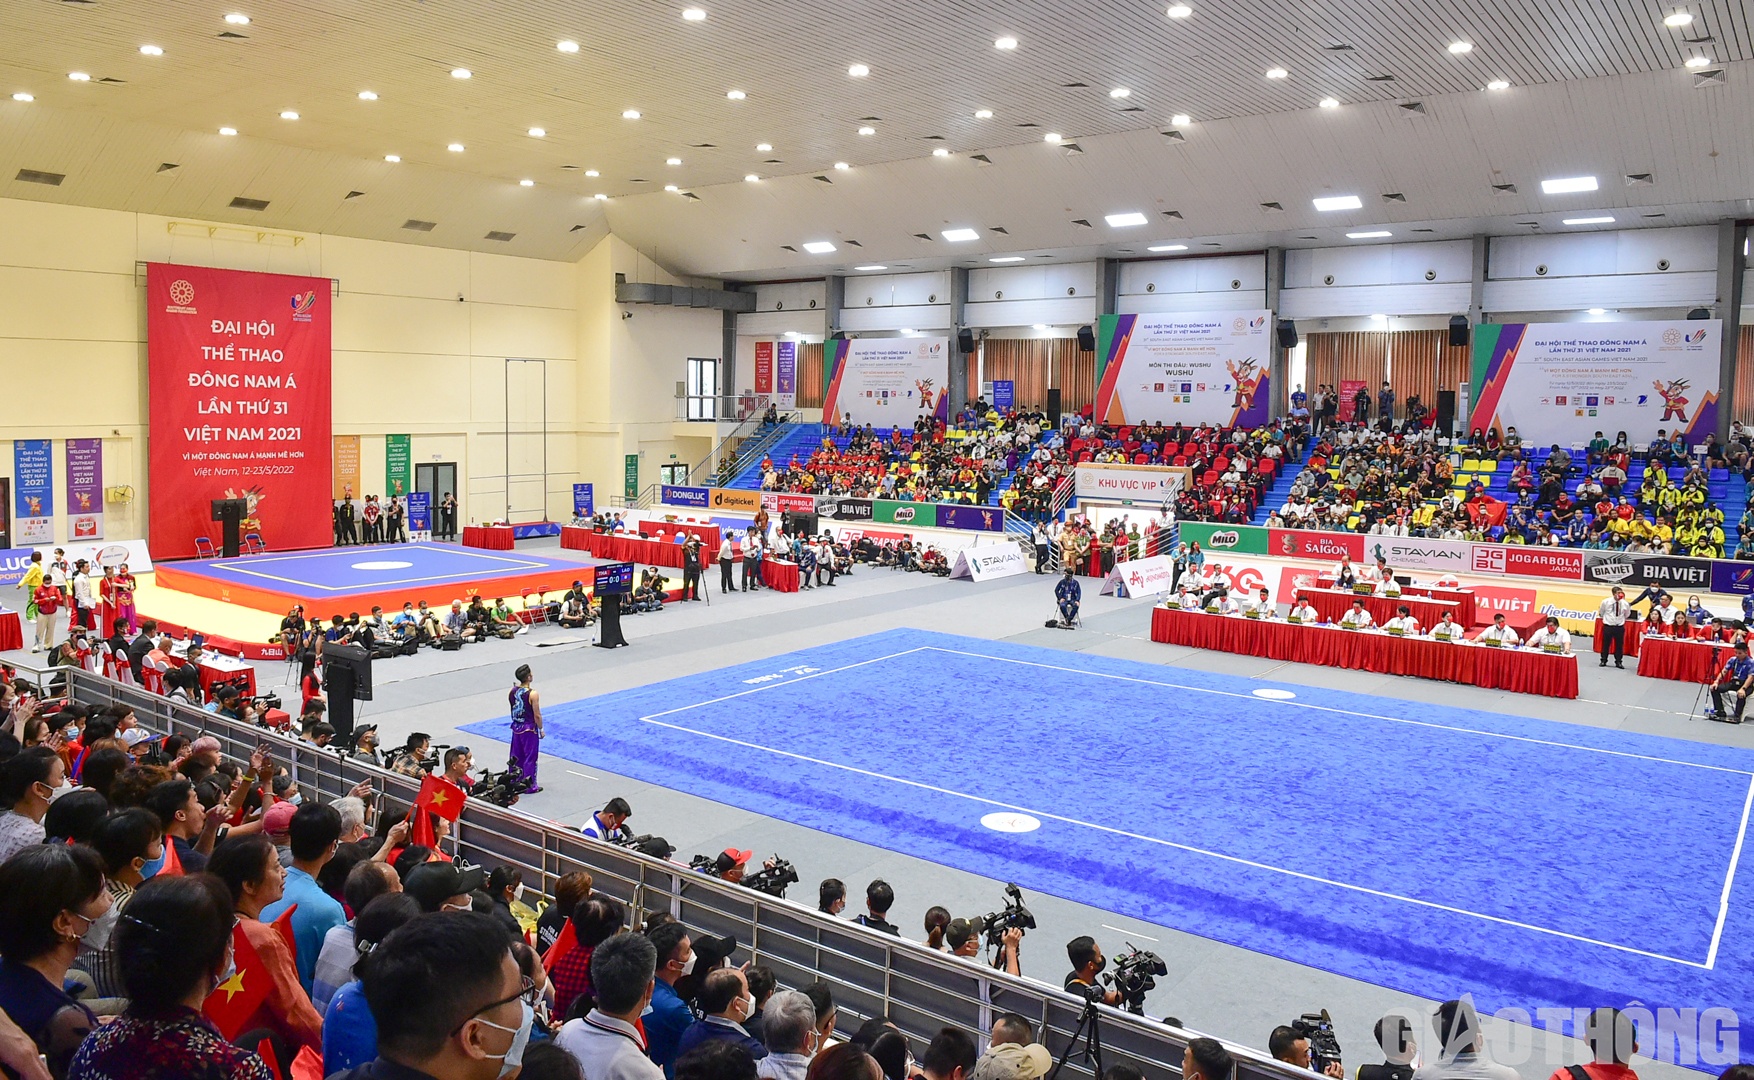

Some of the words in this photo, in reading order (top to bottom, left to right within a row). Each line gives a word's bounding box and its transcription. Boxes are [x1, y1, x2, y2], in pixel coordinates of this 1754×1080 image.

[211, 320, 240, 337] ĐẠI
[246, 320, 274, 339] HỘI
[201, 343, 234, 361] THỂ
[238, 348, 284, 362] THAO
[188, 370, 240, 388] ĐÔNG
[244, 376, 280, 388] NAM
[285, 372, 297, 389] Á
[198, 396, 232, 414] LẦN
[236, 398, 270, 414] THỨ
[274, 402, 288, 414] 31
[184, 424, 221, 444] VIỆT
[226, 428, 264, 440] NAM
[268, 428, 301, 440] 2021
[182, 452, 190, 460] VÌ
[192, 452, 208, 462] MỘT
[209, 452, 231, 460] ĐÔNG
[250, 451, 255, 459] Á
[256, 452, 277, 461] MẠNH
[278, 451, 288, 459] MẼ
[194, 467, 211, 478] Việt
[214, 468, 240, 476] Nam,
[242, 465, 294, 476] 12-23/5/2022
[1099, 479, 1117, 487] KHU
[1120, 480, 1138, 490] VỰC
[1142, 482, 1156, 490] VIP
[673, 491, 705, 500] DONGLUC
[724, 497, 754, 506] digiticket
[842, 505, 855, 514] BIA
[856, 504, 871, 516] VIỆT
[1305, 543, 1348, 555] SAIGON
[1392, 547, 1461, 559] STAVIAN
[982, 554, 1020, 566] STAVIAN
[1509, 554, 1580, 566] JOGARBOLA
[1594, 567, 1609, 575] BIA
[1611, 565, 1630, 574] VIỆT
[1643, 565, 1670, 579] BIA
[1671, 566, 1707, 583] VIỆT
[1541, 604, 1597, 620] Vietravel
